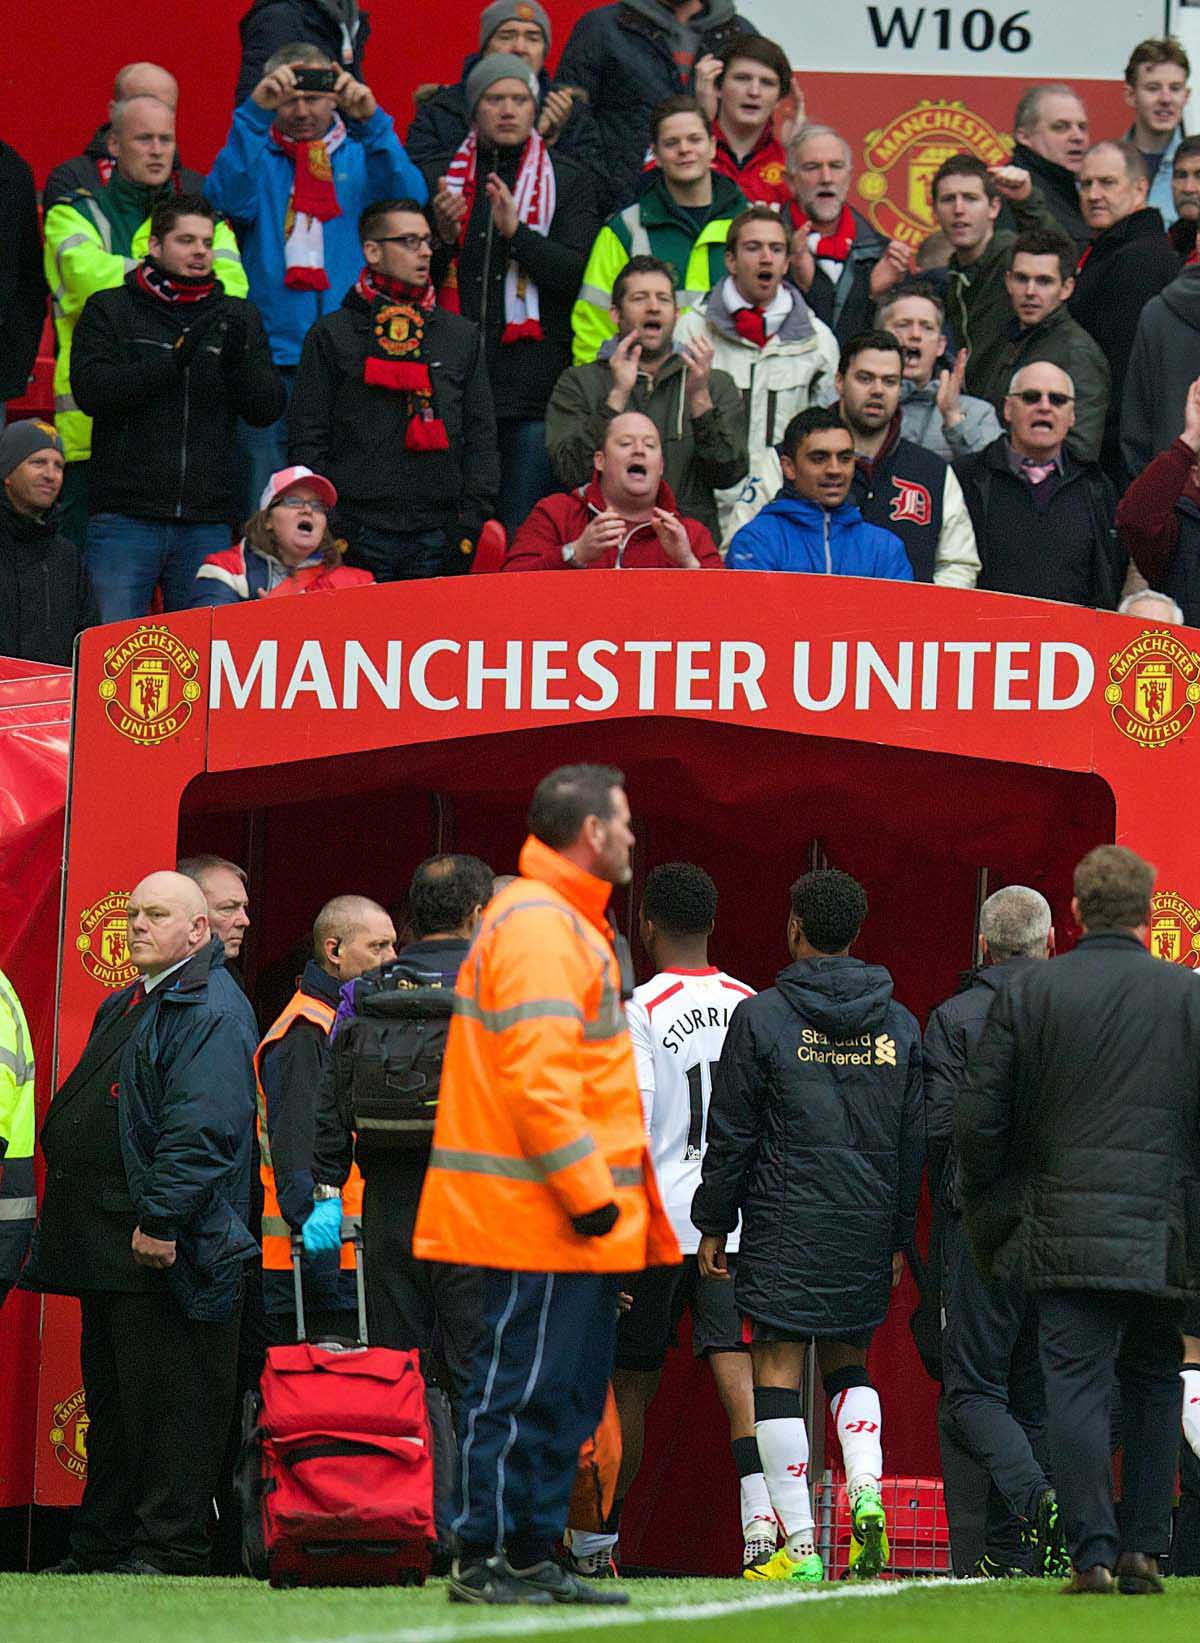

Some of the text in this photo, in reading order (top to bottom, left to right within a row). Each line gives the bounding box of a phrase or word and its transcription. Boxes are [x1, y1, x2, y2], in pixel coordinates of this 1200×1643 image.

[867, 6, 1032, 53] W106
[875, 112, 1005, 166] MANCHESTER
[110, 634, 192, 674] MANCHESTER
[1115, 638, 1195, 677] MANCHESTER
[209, 639, 1095, 712] MANCHESTER UNITED
[120, 715, 177, 737] UNITED
[1126, 719, 1182, 740] UNITED
[93, 963, 139, 981] UNITED
[662, 1006, 729, 1055] STURRI
[801, 1029, 872, 1047] Staard
[797, 1046, 872, 1066] Chartered
